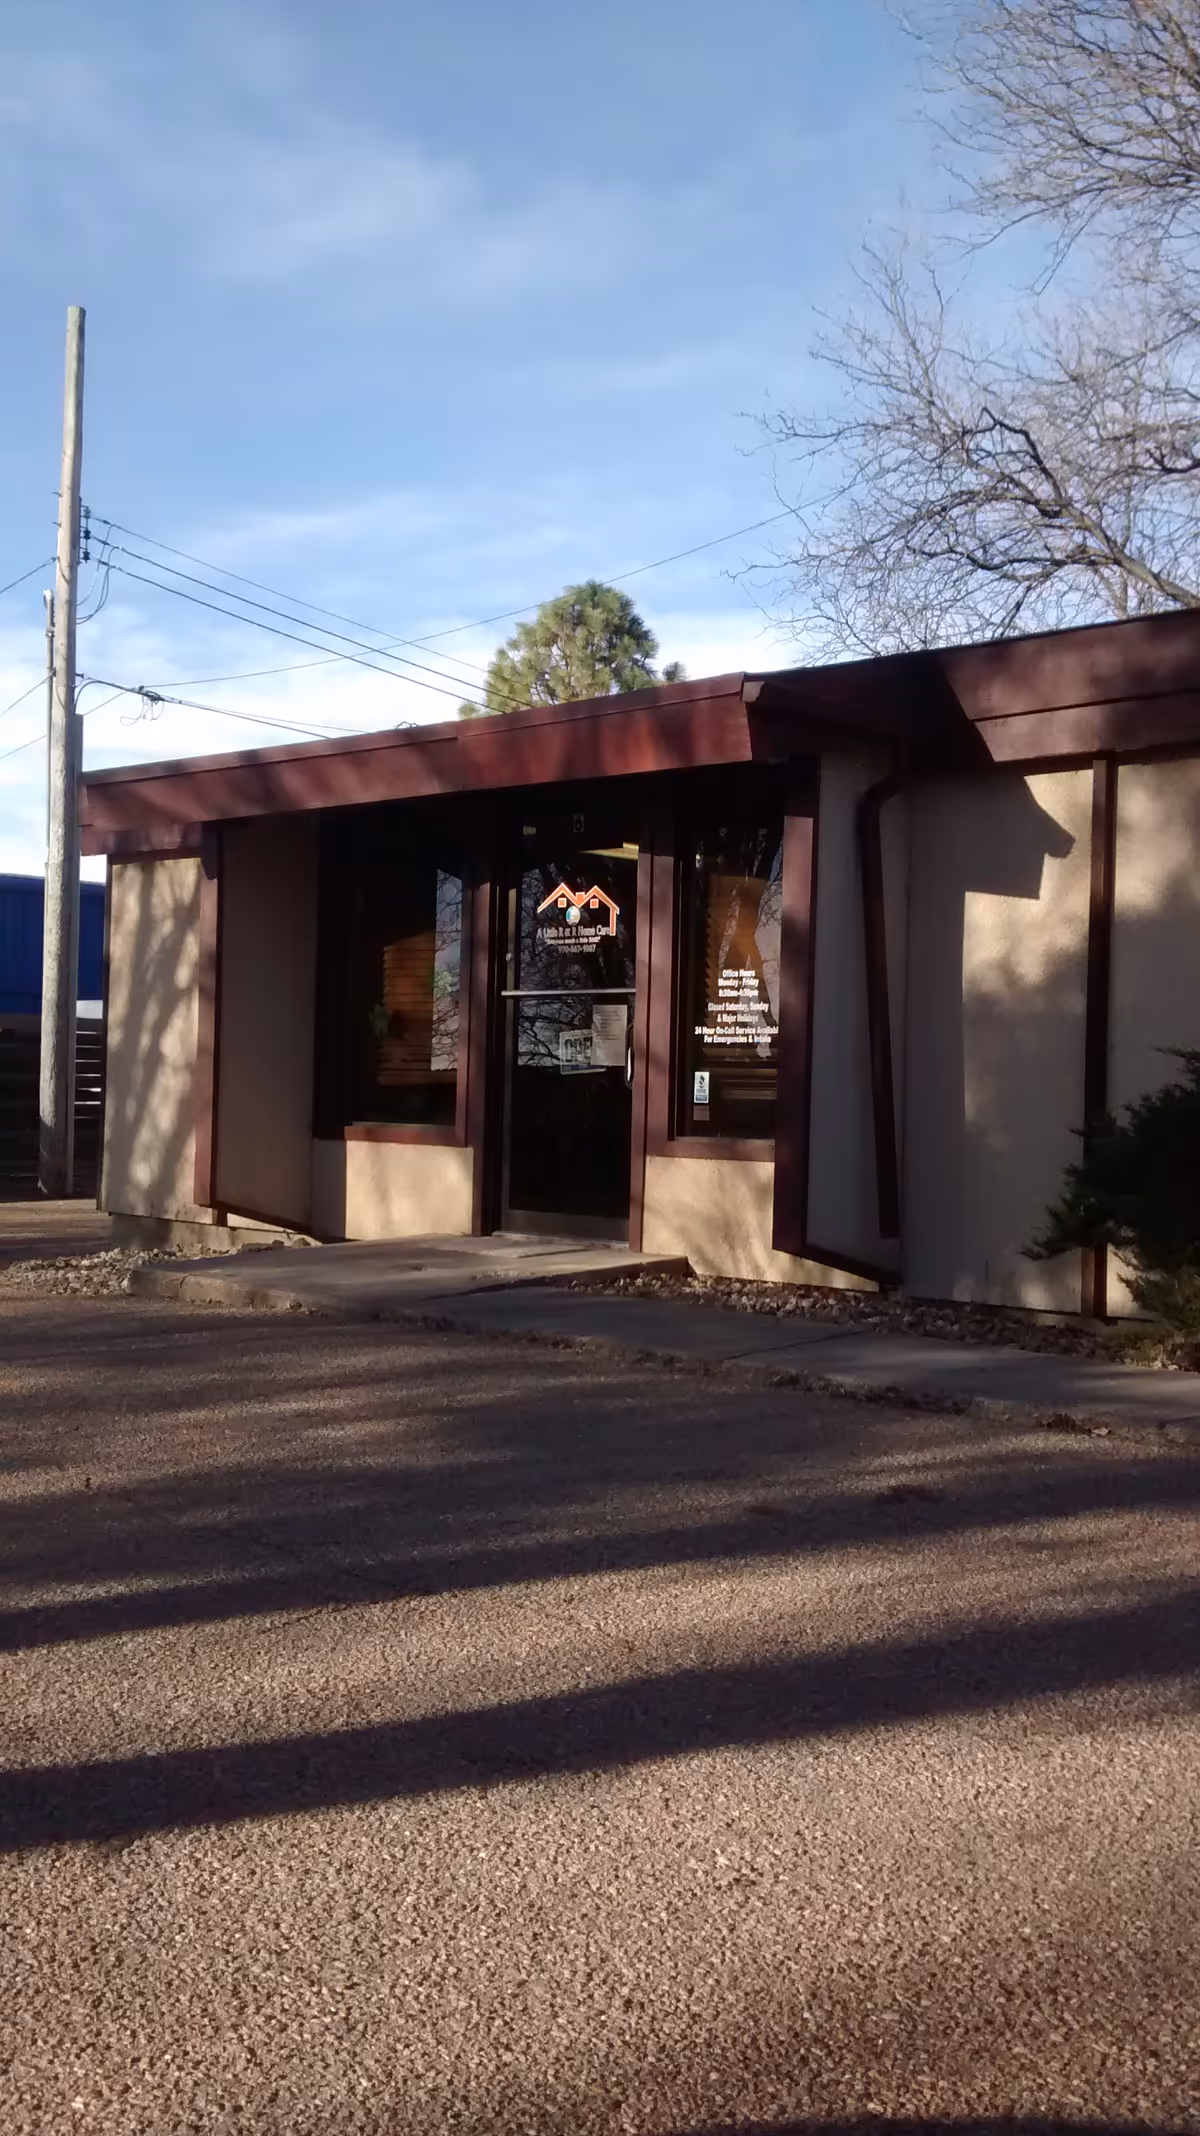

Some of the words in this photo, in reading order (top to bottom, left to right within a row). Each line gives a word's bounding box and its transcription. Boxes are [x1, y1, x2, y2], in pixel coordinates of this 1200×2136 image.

[578, 926, 595, 936] Home
[722, 969, 739, 978] Office
[739, 969, 756, 977] Hours
[718, 978, 739, 988] Monday
[742, 978, 760, 987] Friday
[708, 1002, 725, 1011] Closed
[725, 1002, 749, 1012] Saturday,
[750, 1001, 769, 1012] Sunday
[722, 1014, 737, 1024] Major
[737, 1013, 759, 1024] Holidays
[694, 1026, 702, 1035] 24
[702, 1026, 715, 1035] Hour
[715, 1026, 735, 1035] On-Call
[735, 1026, 756, 1034] Service
[704, 1035, 713, 1043] For
[713, 1035, 747, 1045] Emergencies
[748, 1035, 753, 1043] &
